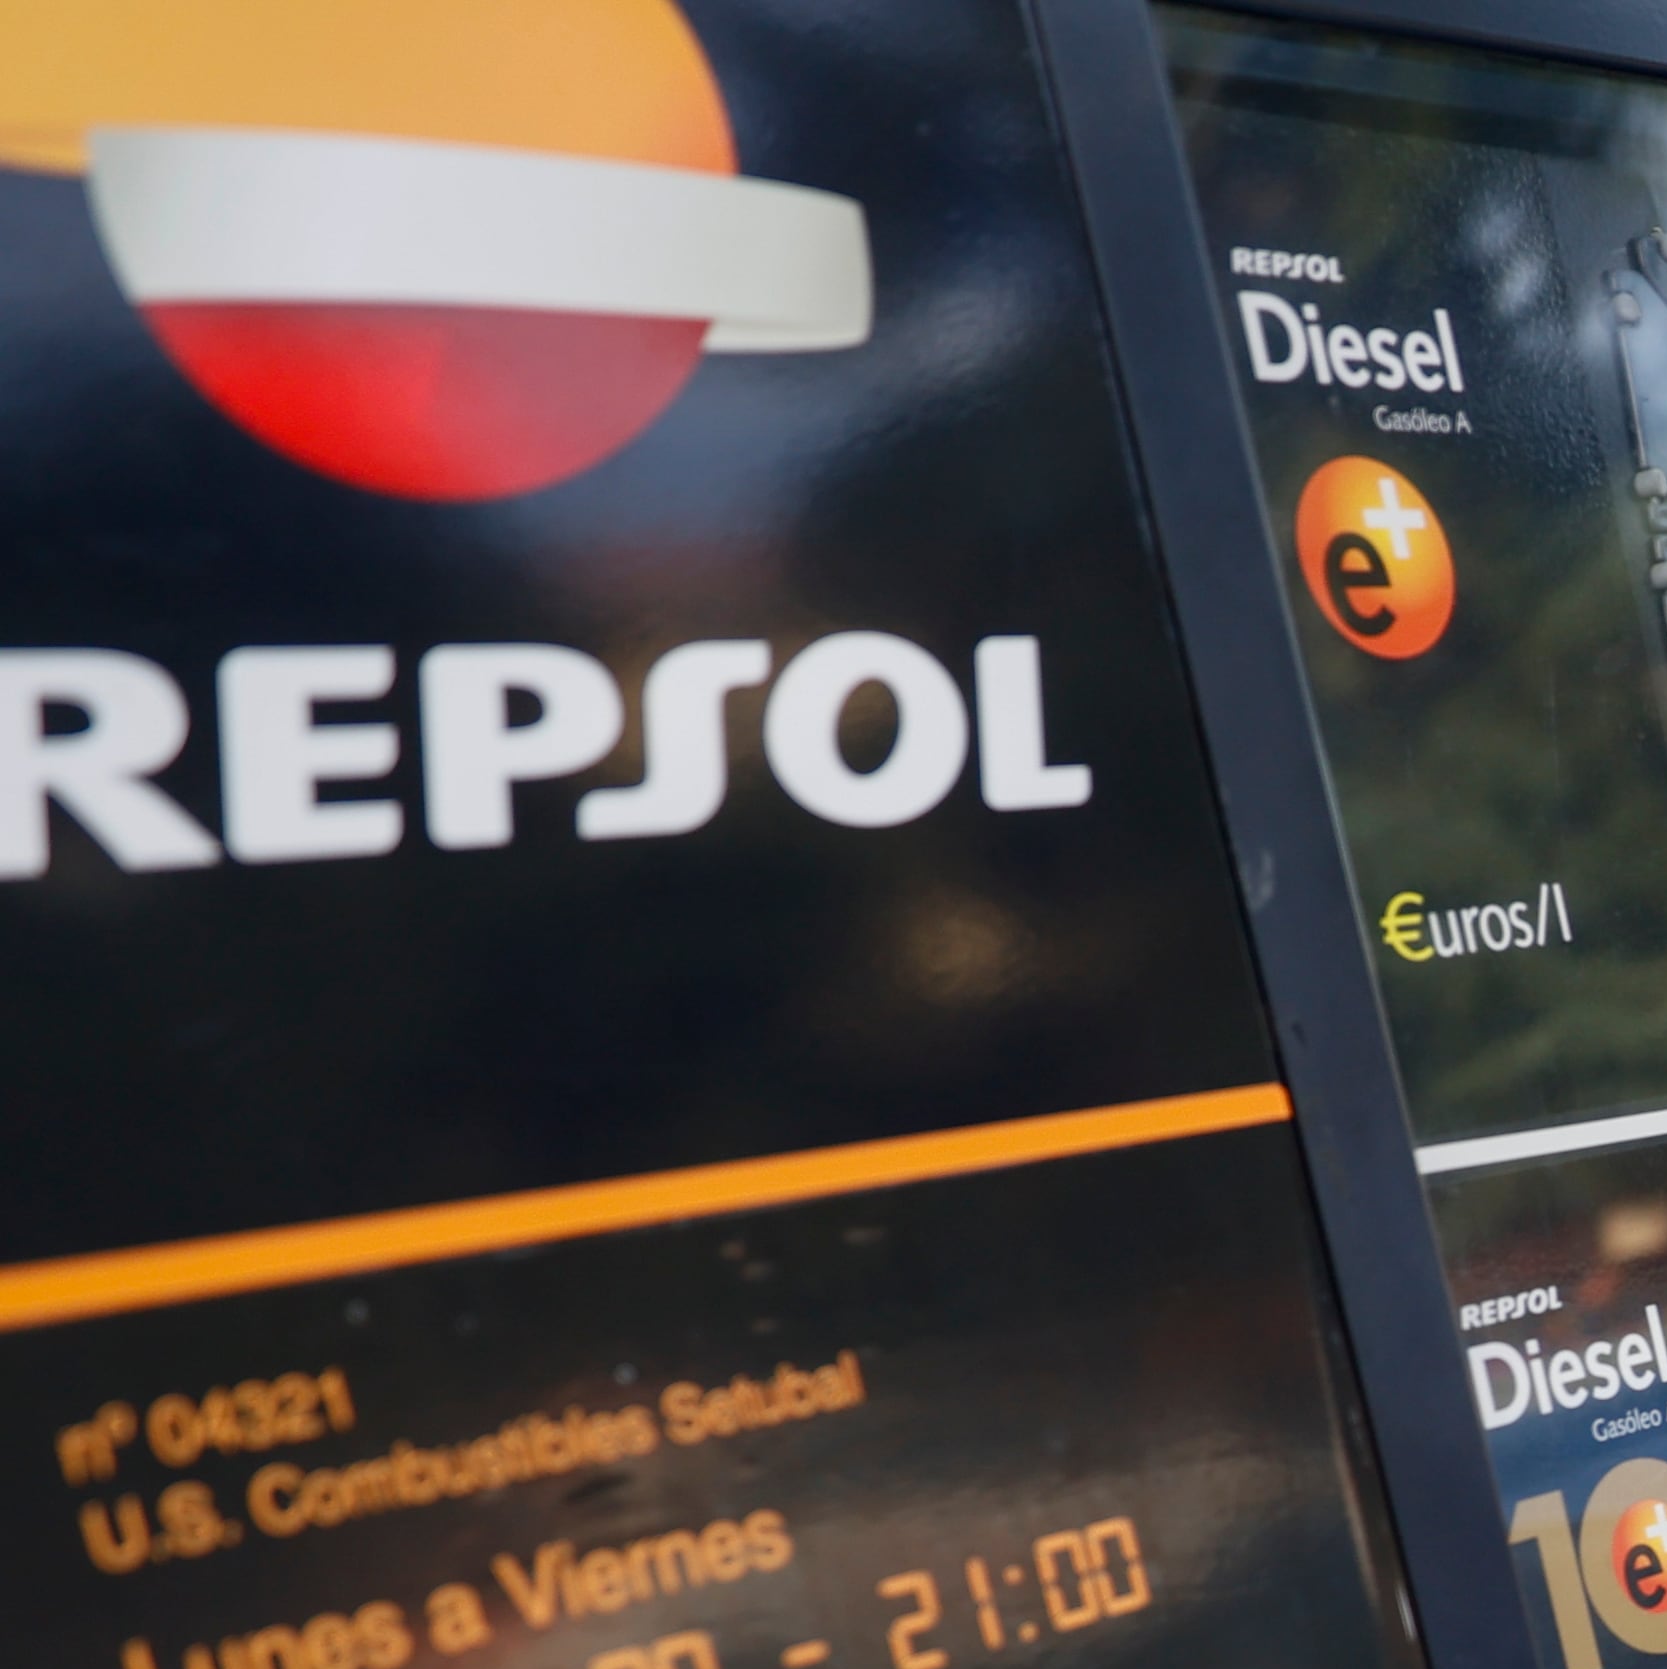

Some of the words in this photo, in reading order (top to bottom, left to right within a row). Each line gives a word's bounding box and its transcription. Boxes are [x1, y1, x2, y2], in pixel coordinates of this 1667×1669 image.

[1231, 248, 1344, 283] REPSOL
[1239, 291, 1464, 393] Diesel
[1374, 405, 1451, 435] Gasóleo
[1453, 410, 1472, 435] A
[0, 630, 1093, 883] REPSOL
[1380, 882, 1573, 963] €uros/l
[1460, 1285, 1562, 1331] REPSOL
[146, 1366, 357, 1468] 04321
[1592, 1405, 1664, 1443] Gasóleo
[78, 1480, 244, 1576] U.S.
[246, 1403, 659, 1539] Combustibles
[426, 1583, 492, 1657] a
[491, 1508, 796, 1631] Viernes
